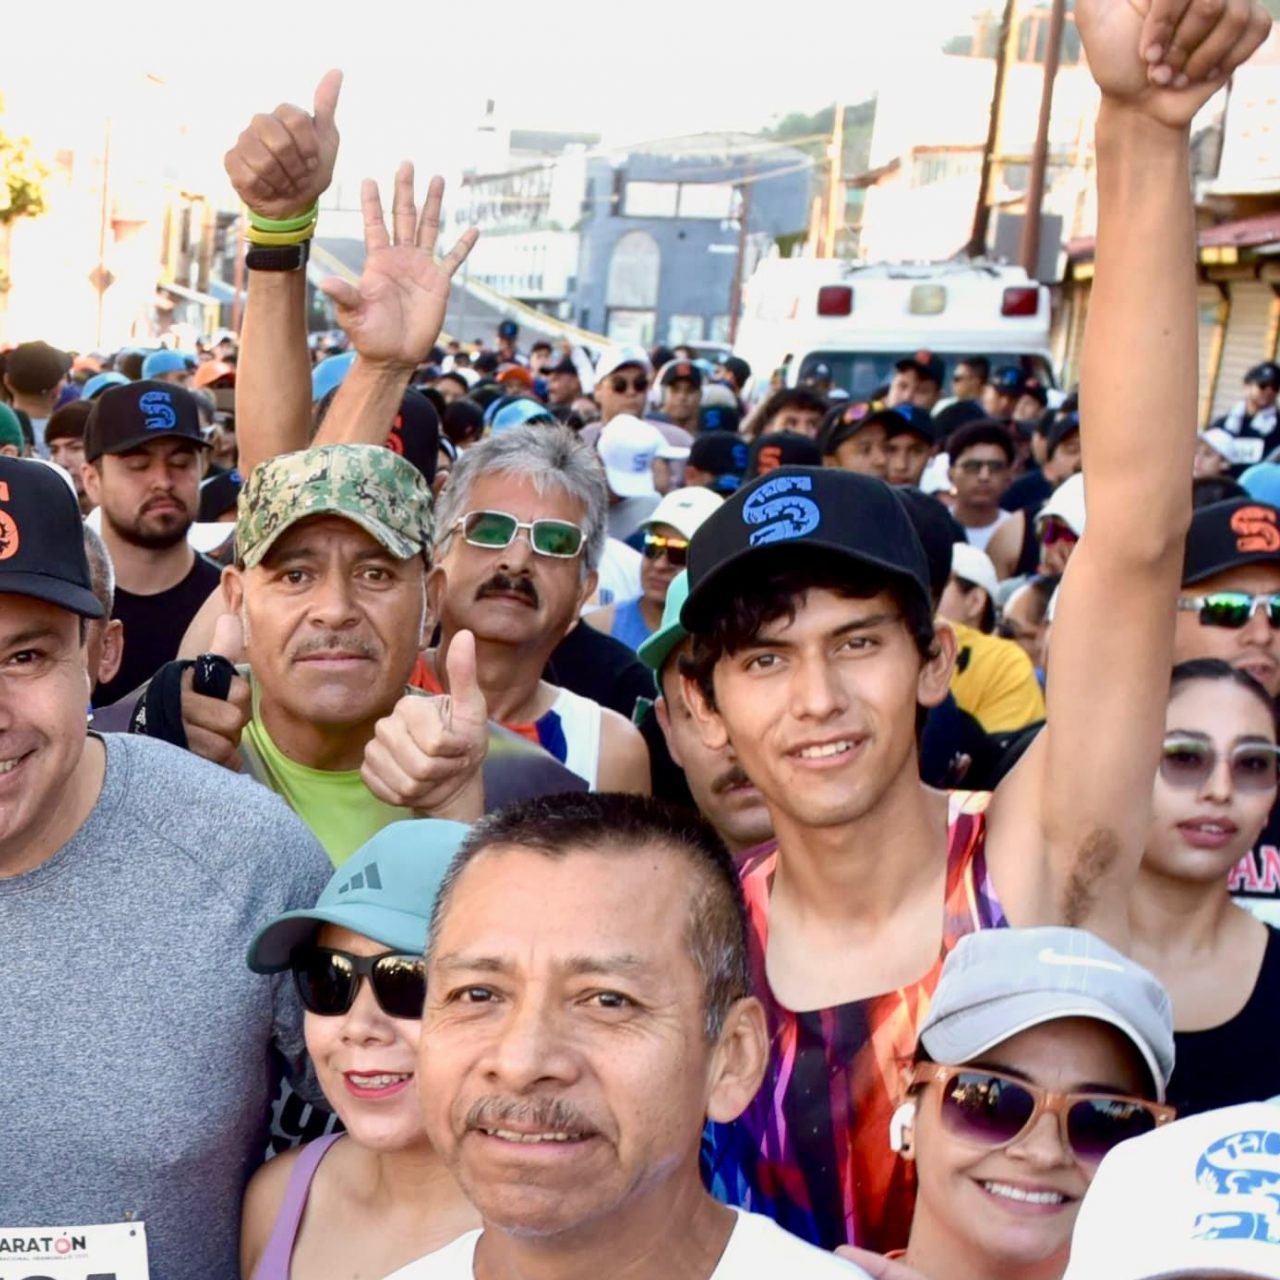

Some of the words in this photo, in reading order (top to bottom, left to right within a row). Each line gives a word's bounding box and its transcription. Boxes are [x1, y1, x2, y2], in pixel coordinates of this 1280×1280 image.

[139, 389, 177, 429] S
[743, 475, 820, 547] S
[1230, 505, 1280, 553] S
